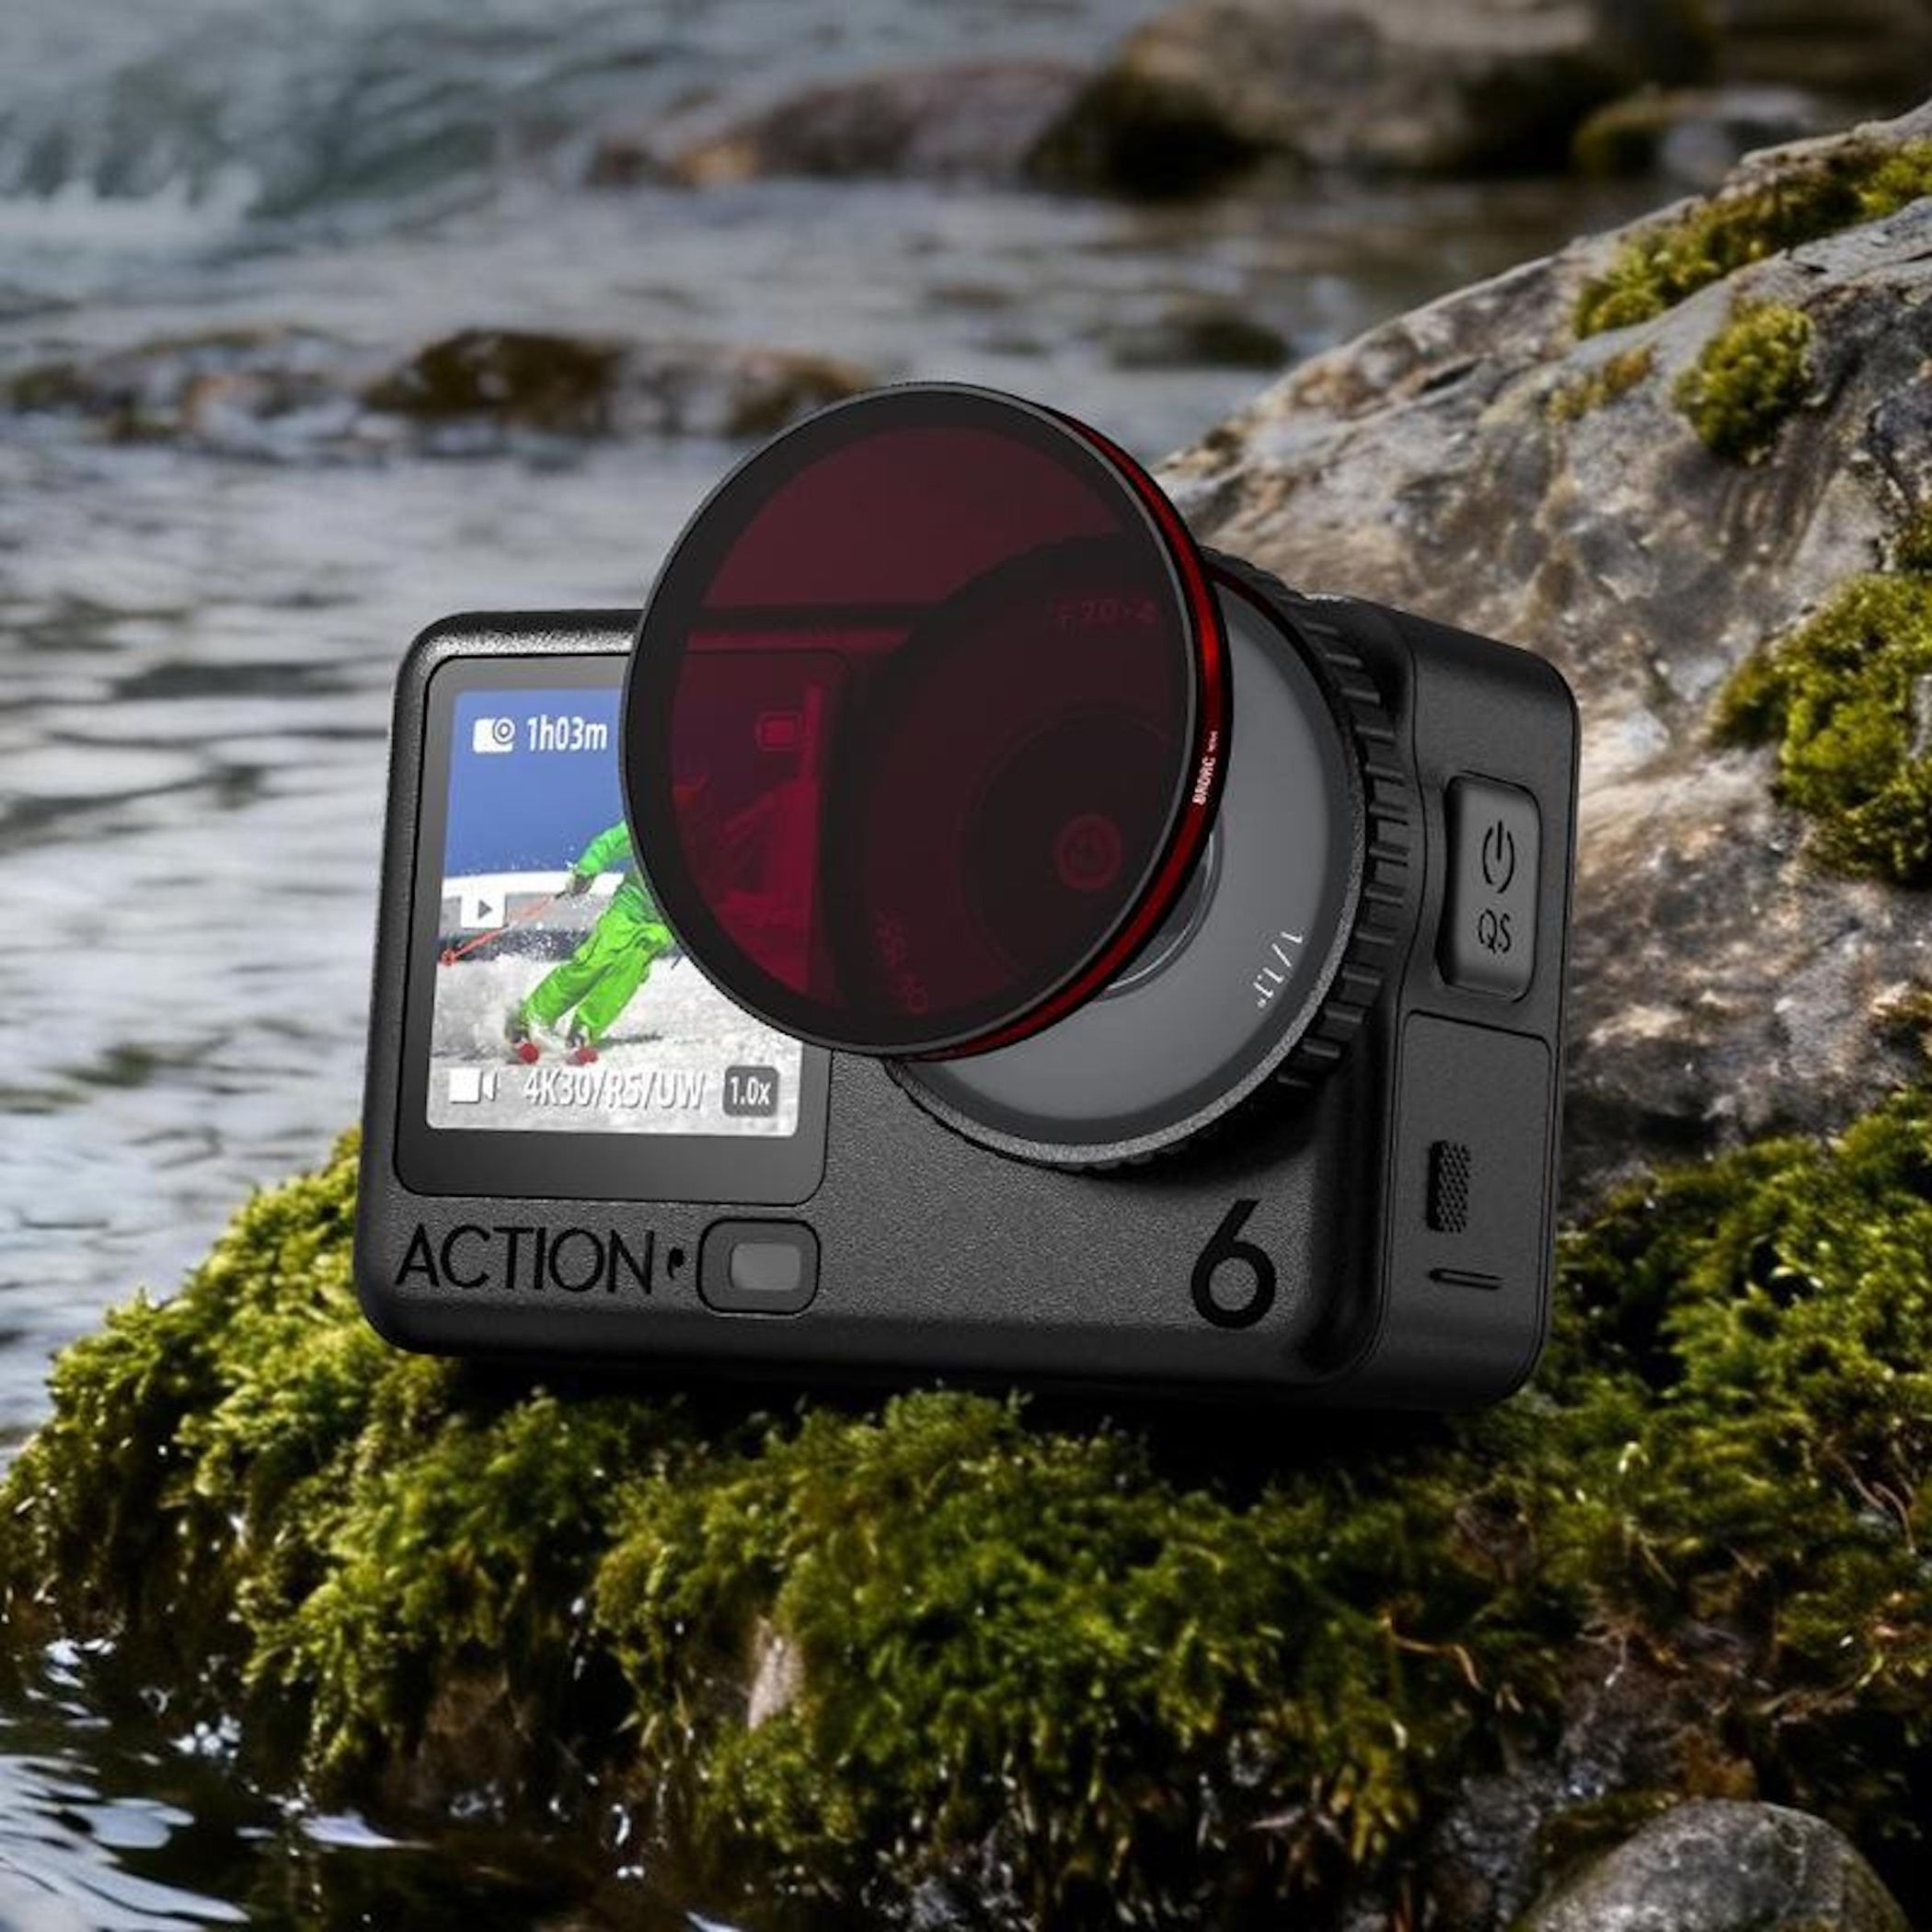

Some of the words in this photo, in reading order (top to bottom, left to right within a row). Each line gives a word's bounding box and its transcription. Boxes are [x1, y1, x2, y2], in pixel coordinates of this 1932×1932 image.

[527, 715, 608, 752] 1h03m
[1478, 908, 1512, 955] QS
[729, 1075, 771, 1106] 1.0x
[395, 1224, 654, 1294] ACTION
[1191, 1200, 1277, 1329] 6
